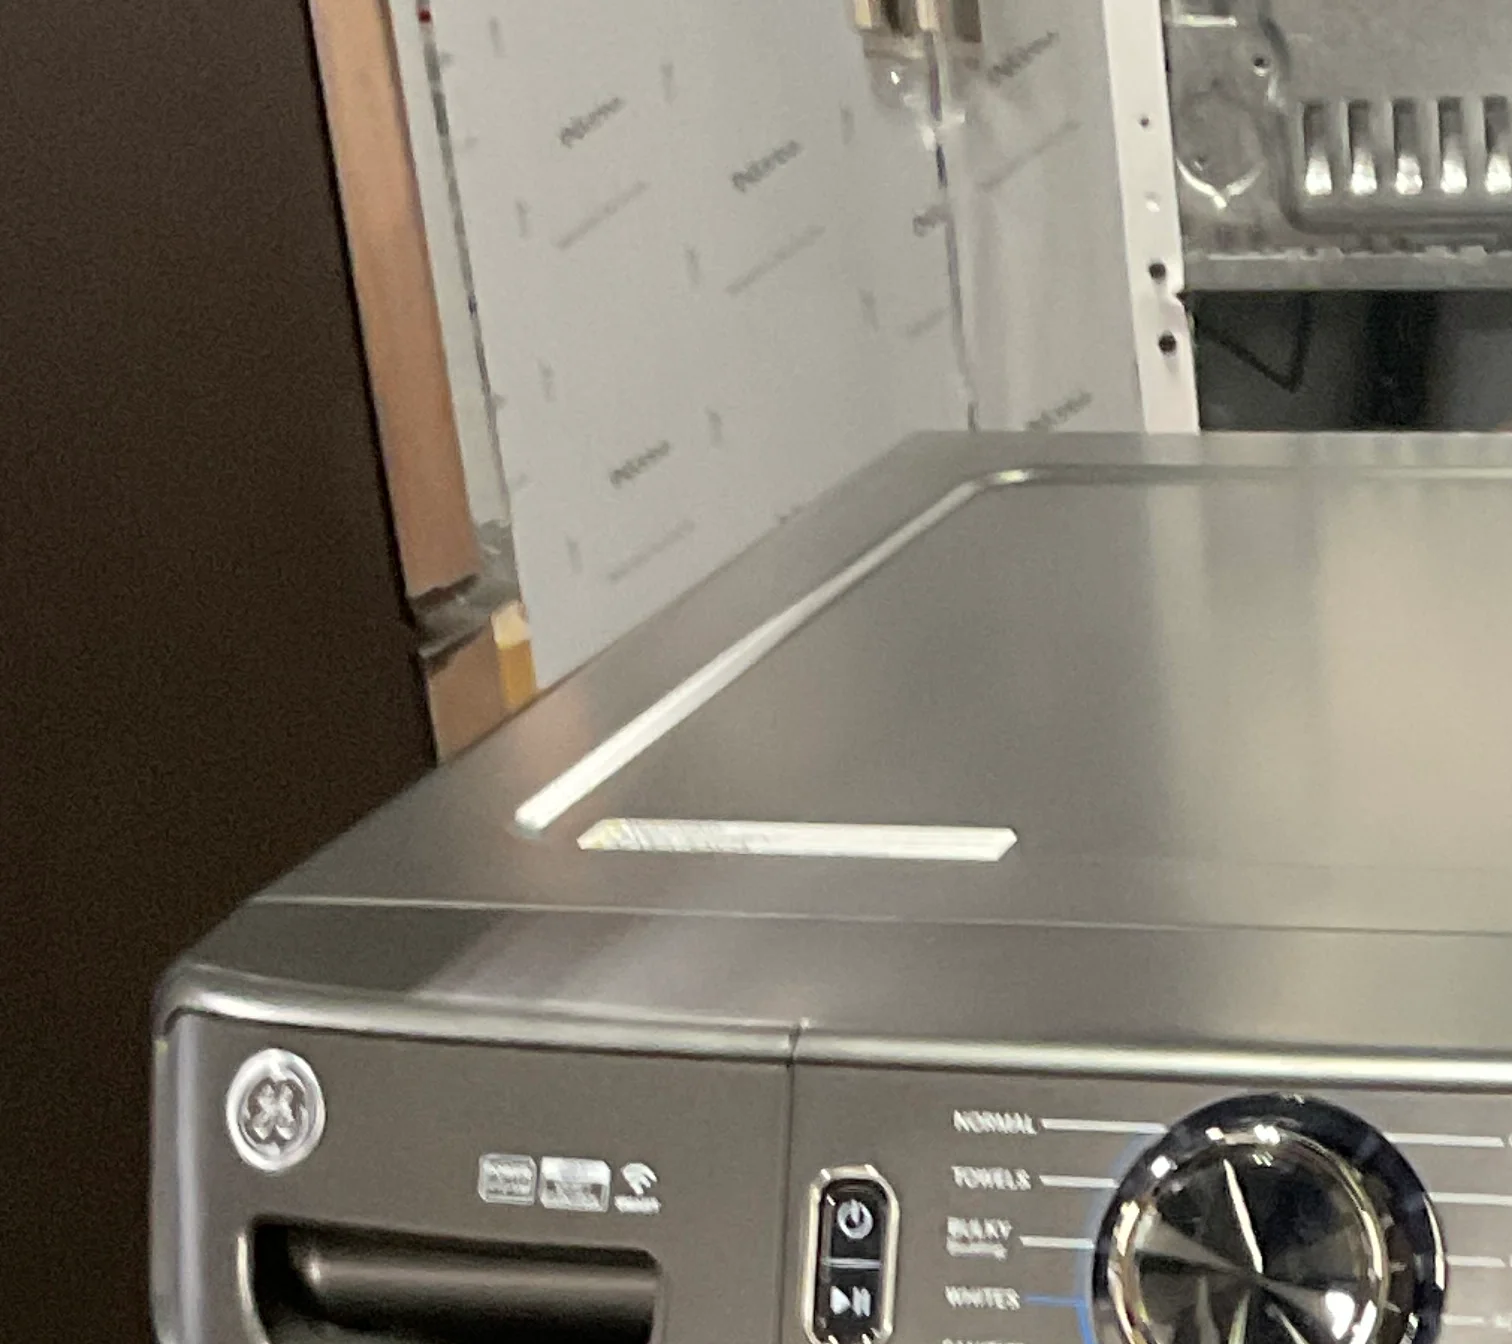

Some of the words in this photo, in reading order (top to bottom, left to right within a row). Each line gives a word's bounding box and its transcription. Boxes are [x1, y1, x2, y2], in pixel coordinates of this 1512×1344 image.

[953, 1109, 1037, 1135] NORMAL
[951, 1166, 1032, 1191] TOWELS
[944, 1286, 1021, 1310] WHITES
